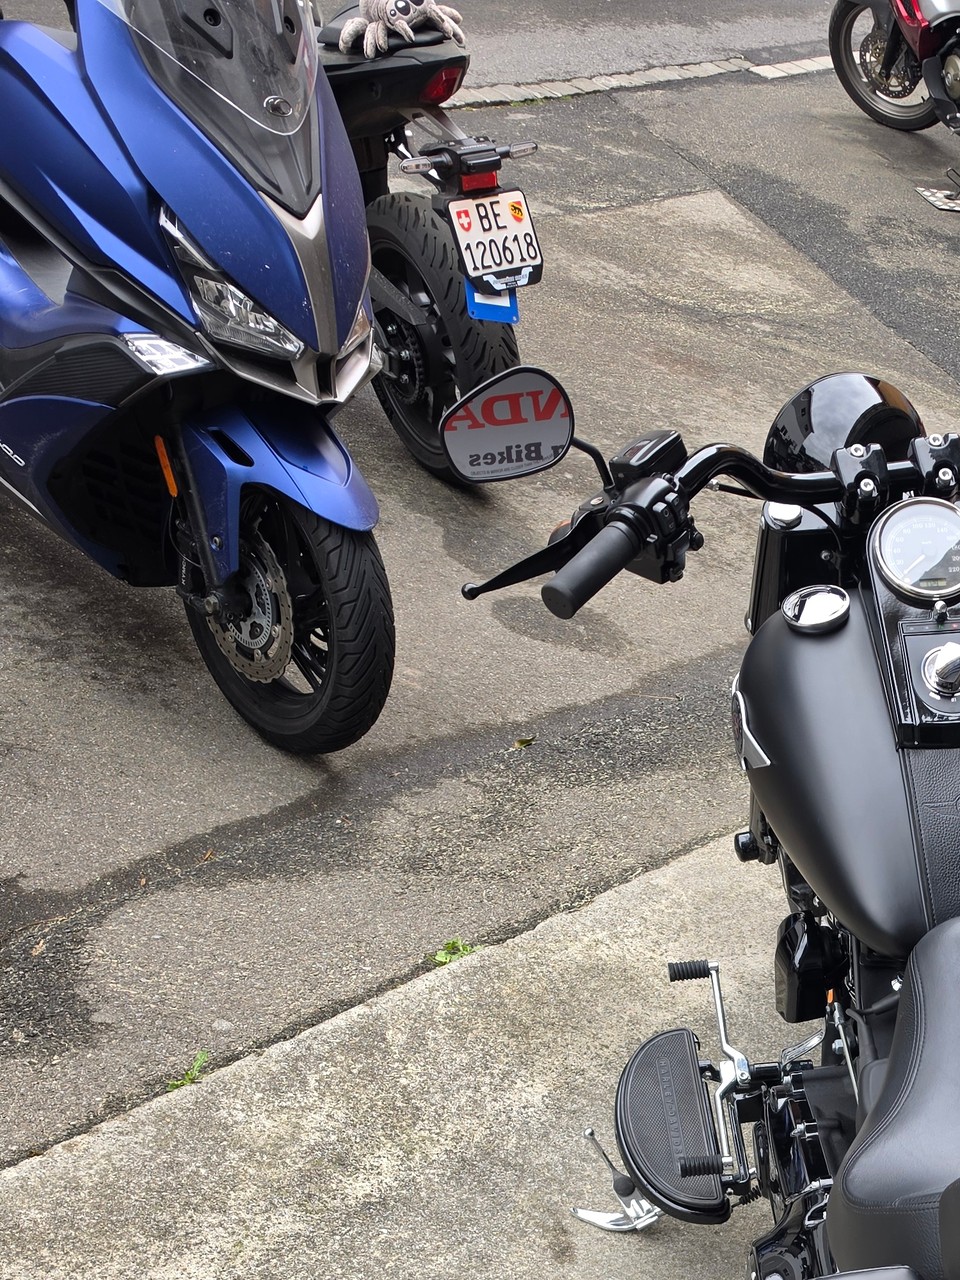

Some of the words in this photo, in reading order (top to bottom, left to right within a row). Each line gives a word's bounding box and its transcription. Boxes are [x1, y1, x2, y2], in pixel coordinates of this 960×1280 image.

[475, 201, 507, 232] BE
[464, 232, 538, 271] 120618
[660, 1060, 683, 1157] HARLEY-DAVIDS
